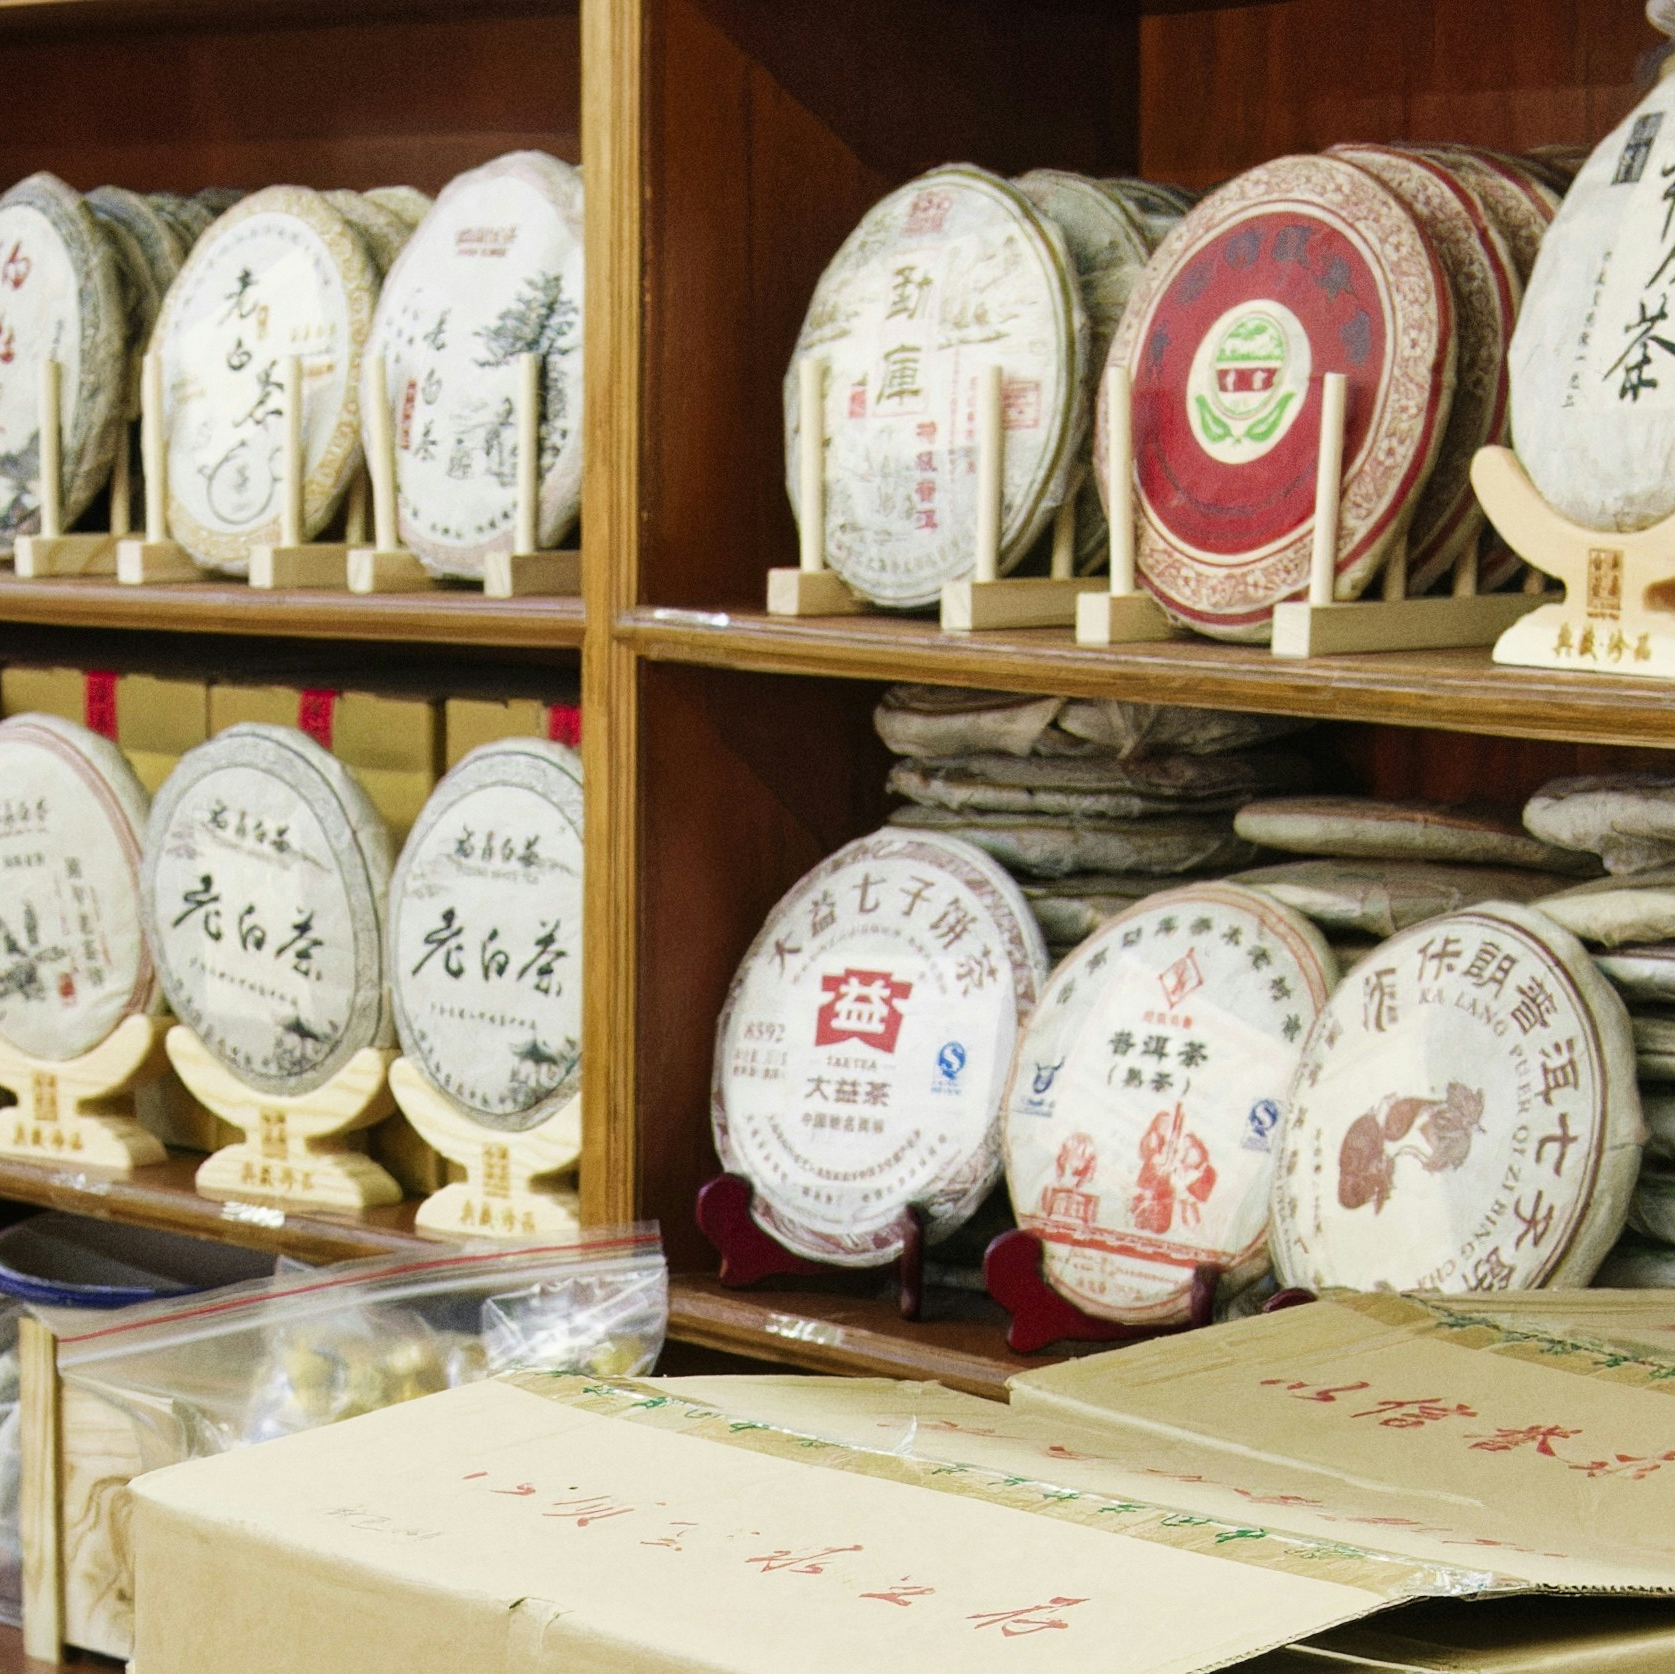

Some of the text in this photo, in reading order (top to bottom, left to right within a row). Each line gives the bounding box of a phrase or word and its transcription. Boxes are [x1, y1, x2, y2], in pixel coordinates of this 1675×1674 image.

[172, 872, 326, 983] 老白茶
[411, 906, 570, 998] 老白茶
[830, 977, 892, 1035] 益
[1108, 1029, 1210, 1070] 普洱茶
[803, 1074, 891, 1108] 大益茶
